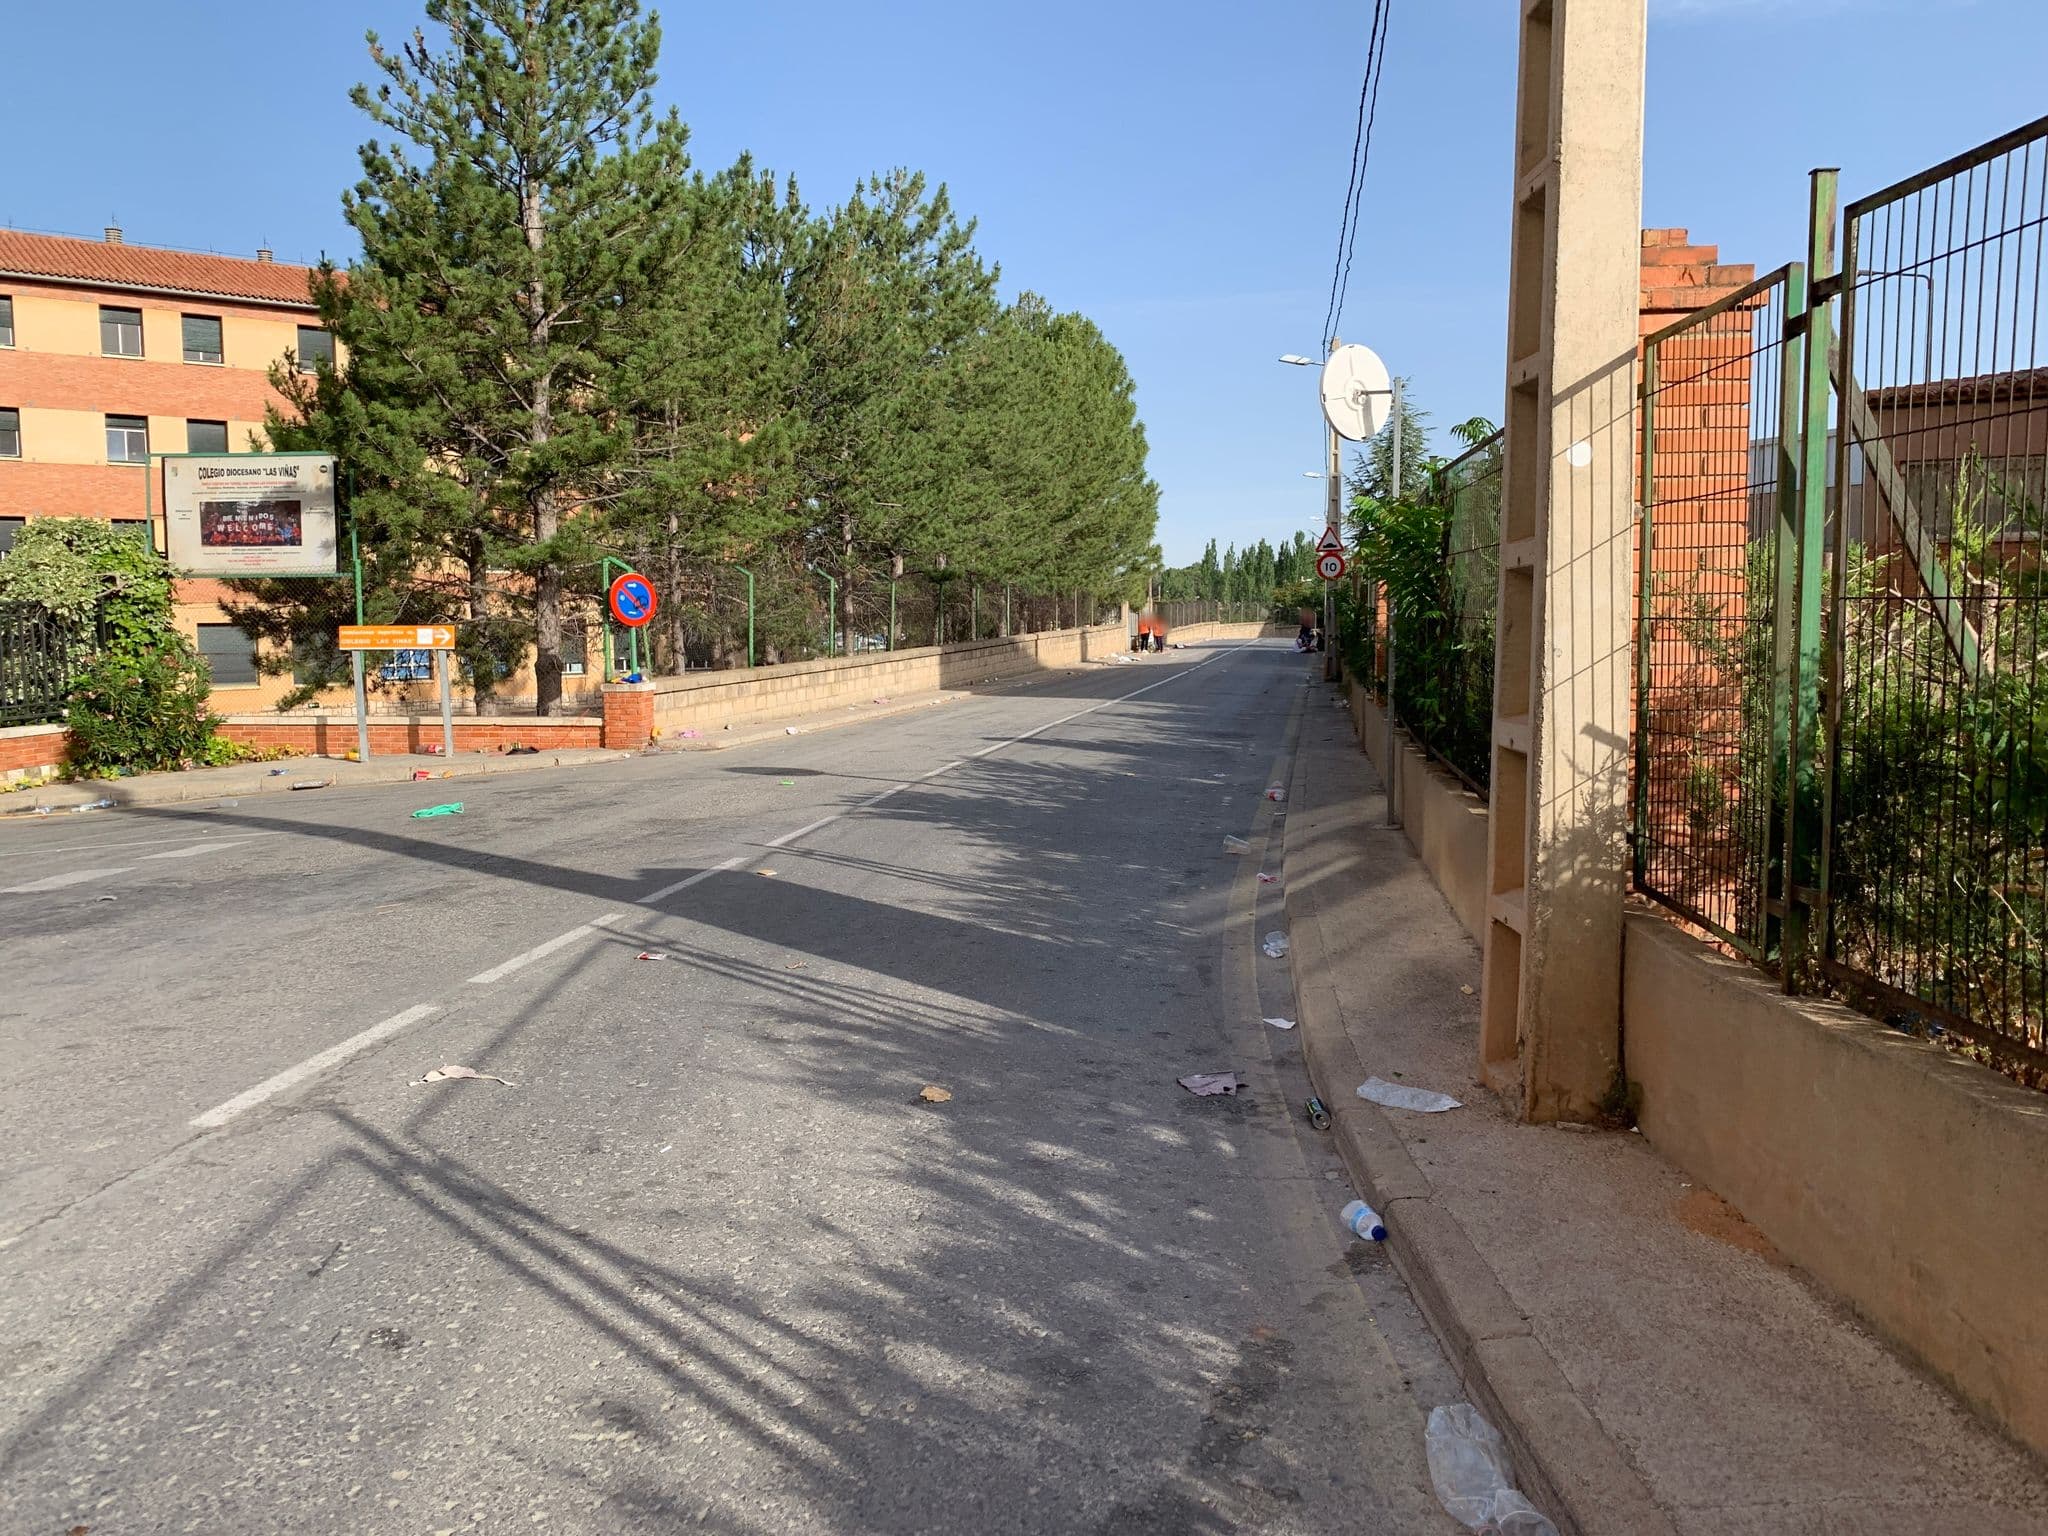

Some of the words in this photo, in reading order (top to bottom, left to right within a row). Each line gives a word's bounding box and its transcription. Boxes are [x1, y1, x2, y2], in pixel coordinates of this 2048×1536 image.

[198, 466, 225, 480] COLEGIO
[226, 468, 262, 477] DIOCESANO
[1325, 562, 1337, 572] 10
